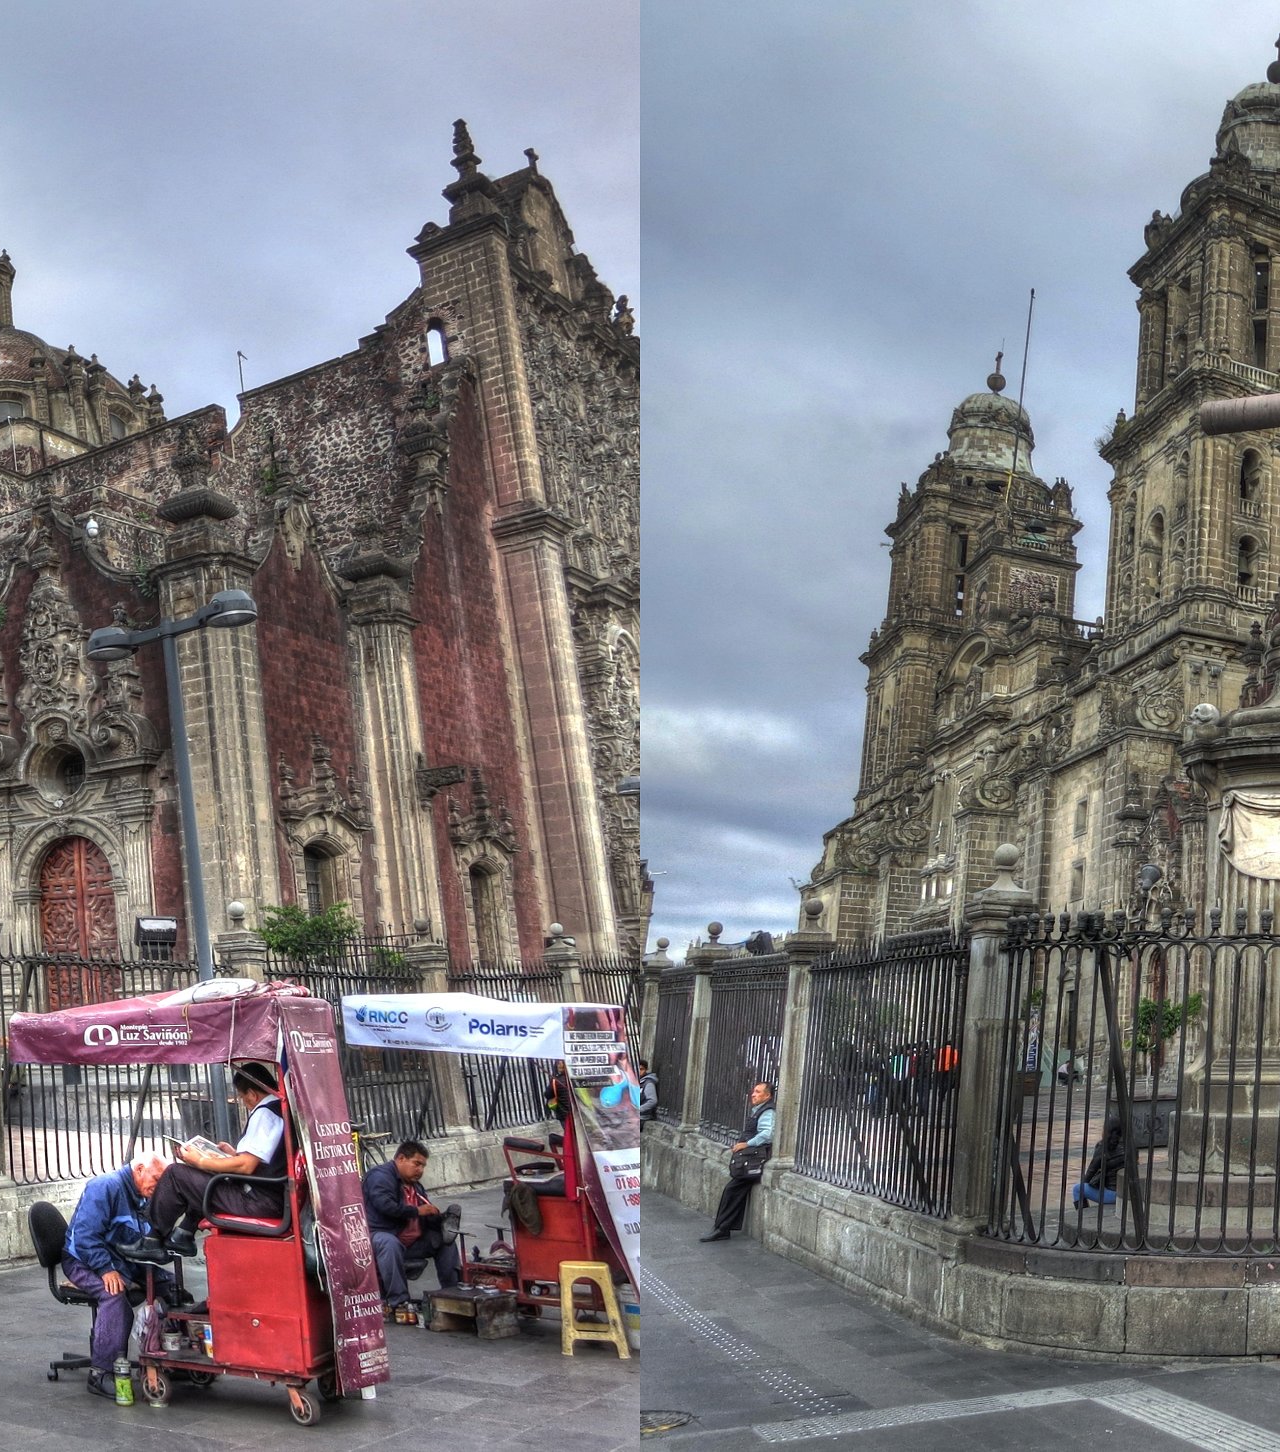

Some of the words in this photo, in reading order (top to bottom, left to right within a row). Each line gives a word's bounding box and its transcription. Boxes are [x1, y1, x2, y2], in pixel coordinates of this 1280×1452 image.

[369, 1010, 408, 1024] RNCC
[120, 1030, 140, 1041] Luz
[143, 1028, 188, 1041] Saviñón
[468, 1018, 529, 1037] Polaris
[315, 1119, 351, 1138] CENTRO
